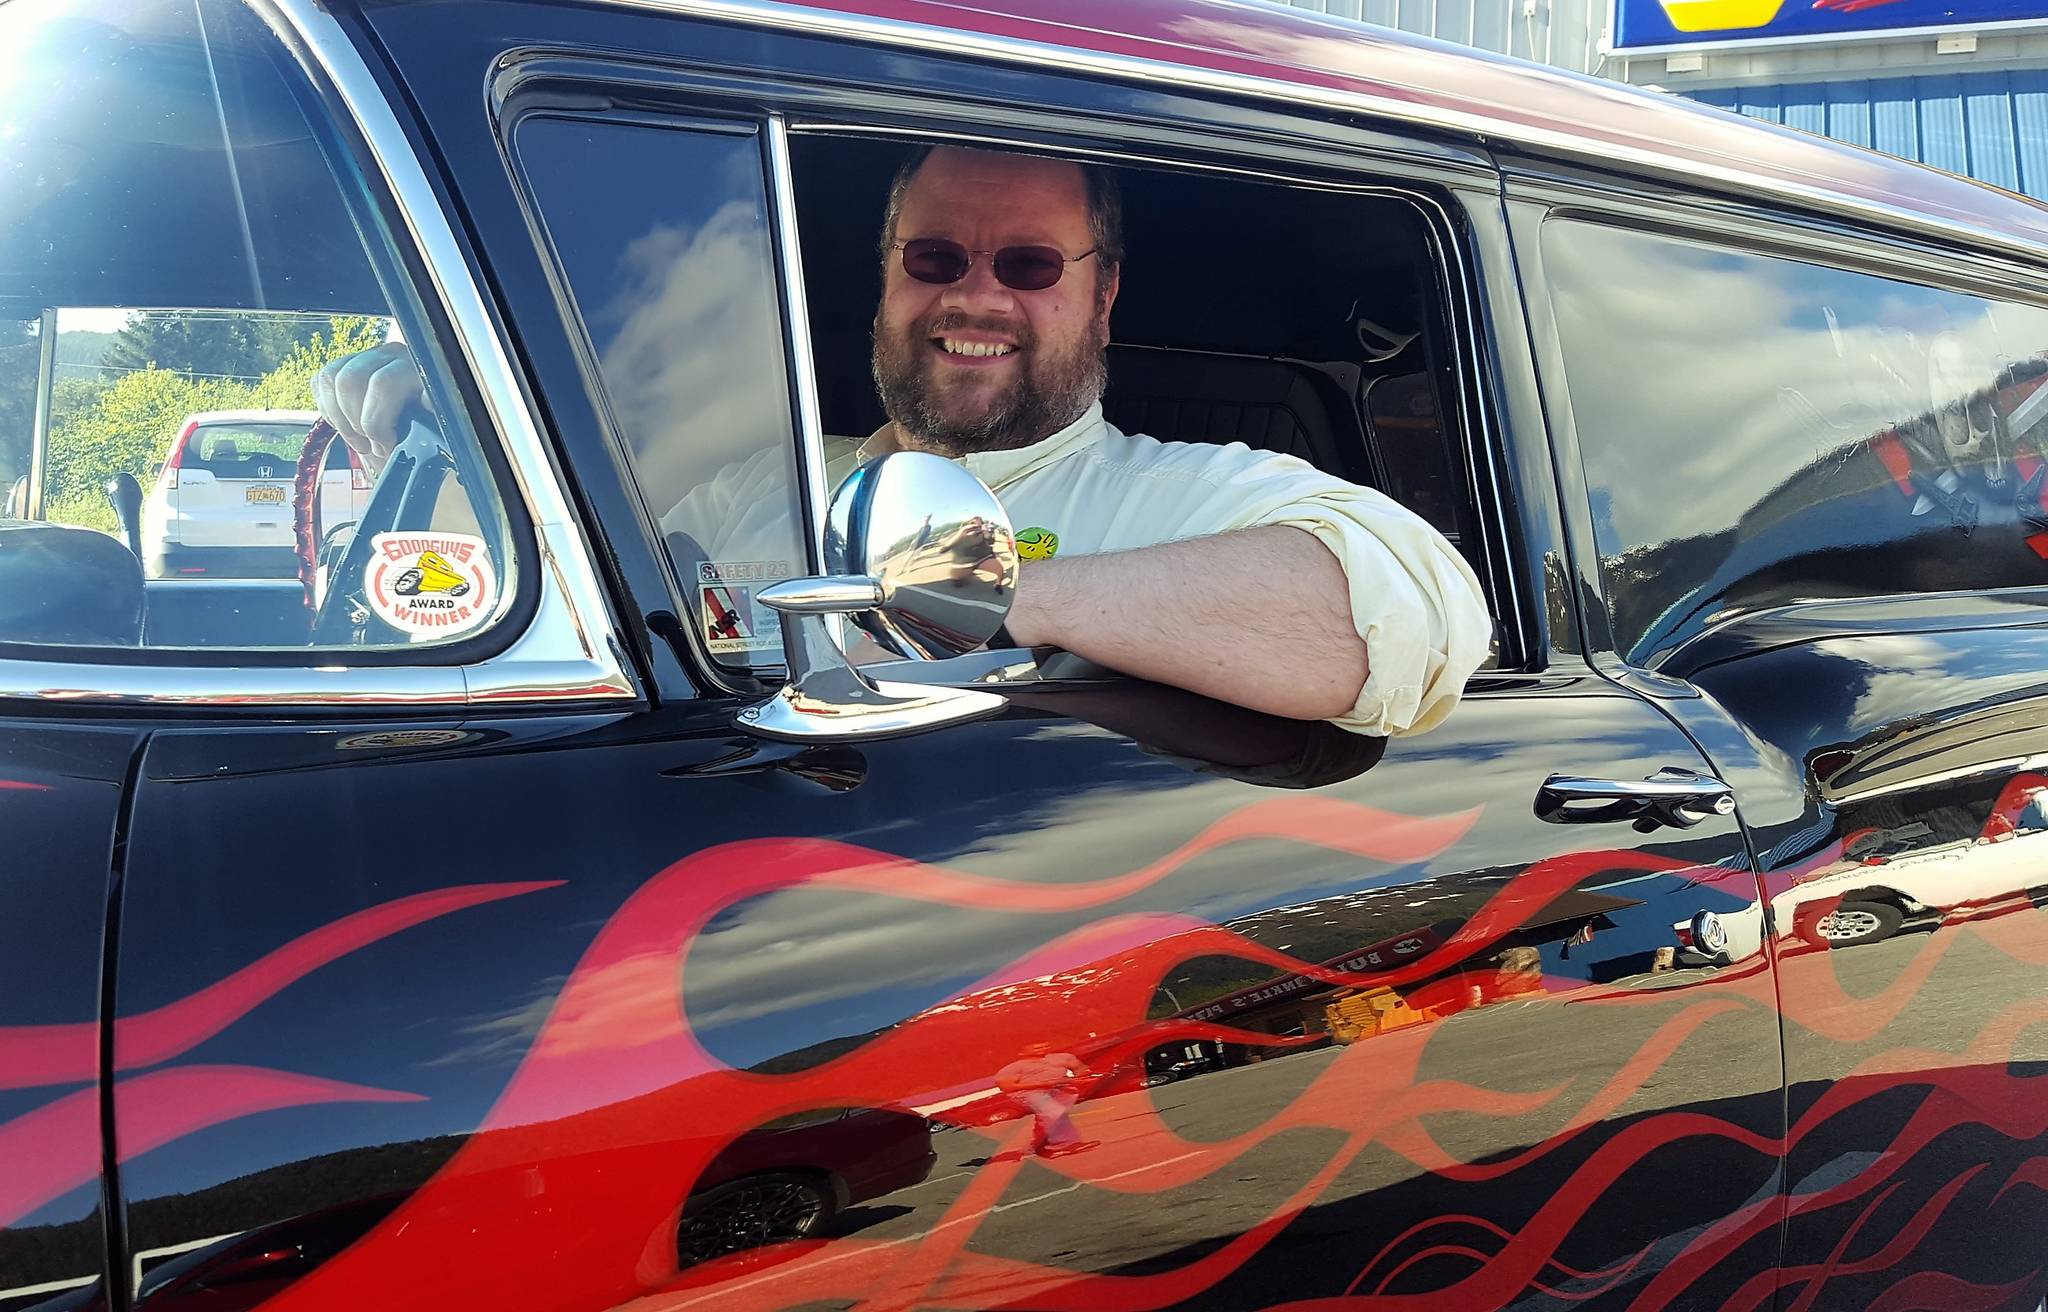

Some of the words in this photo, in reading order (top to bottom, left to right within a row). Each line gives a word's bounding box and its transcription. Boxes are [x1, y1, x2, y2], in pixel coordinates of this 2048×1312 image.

[382, 539, 476, 563] GOODGUYS
[700, 562, 764, 580] SAFETY
[409, 599, 454, 608] AWARD
[394, 604, 471, 626] WINNER
